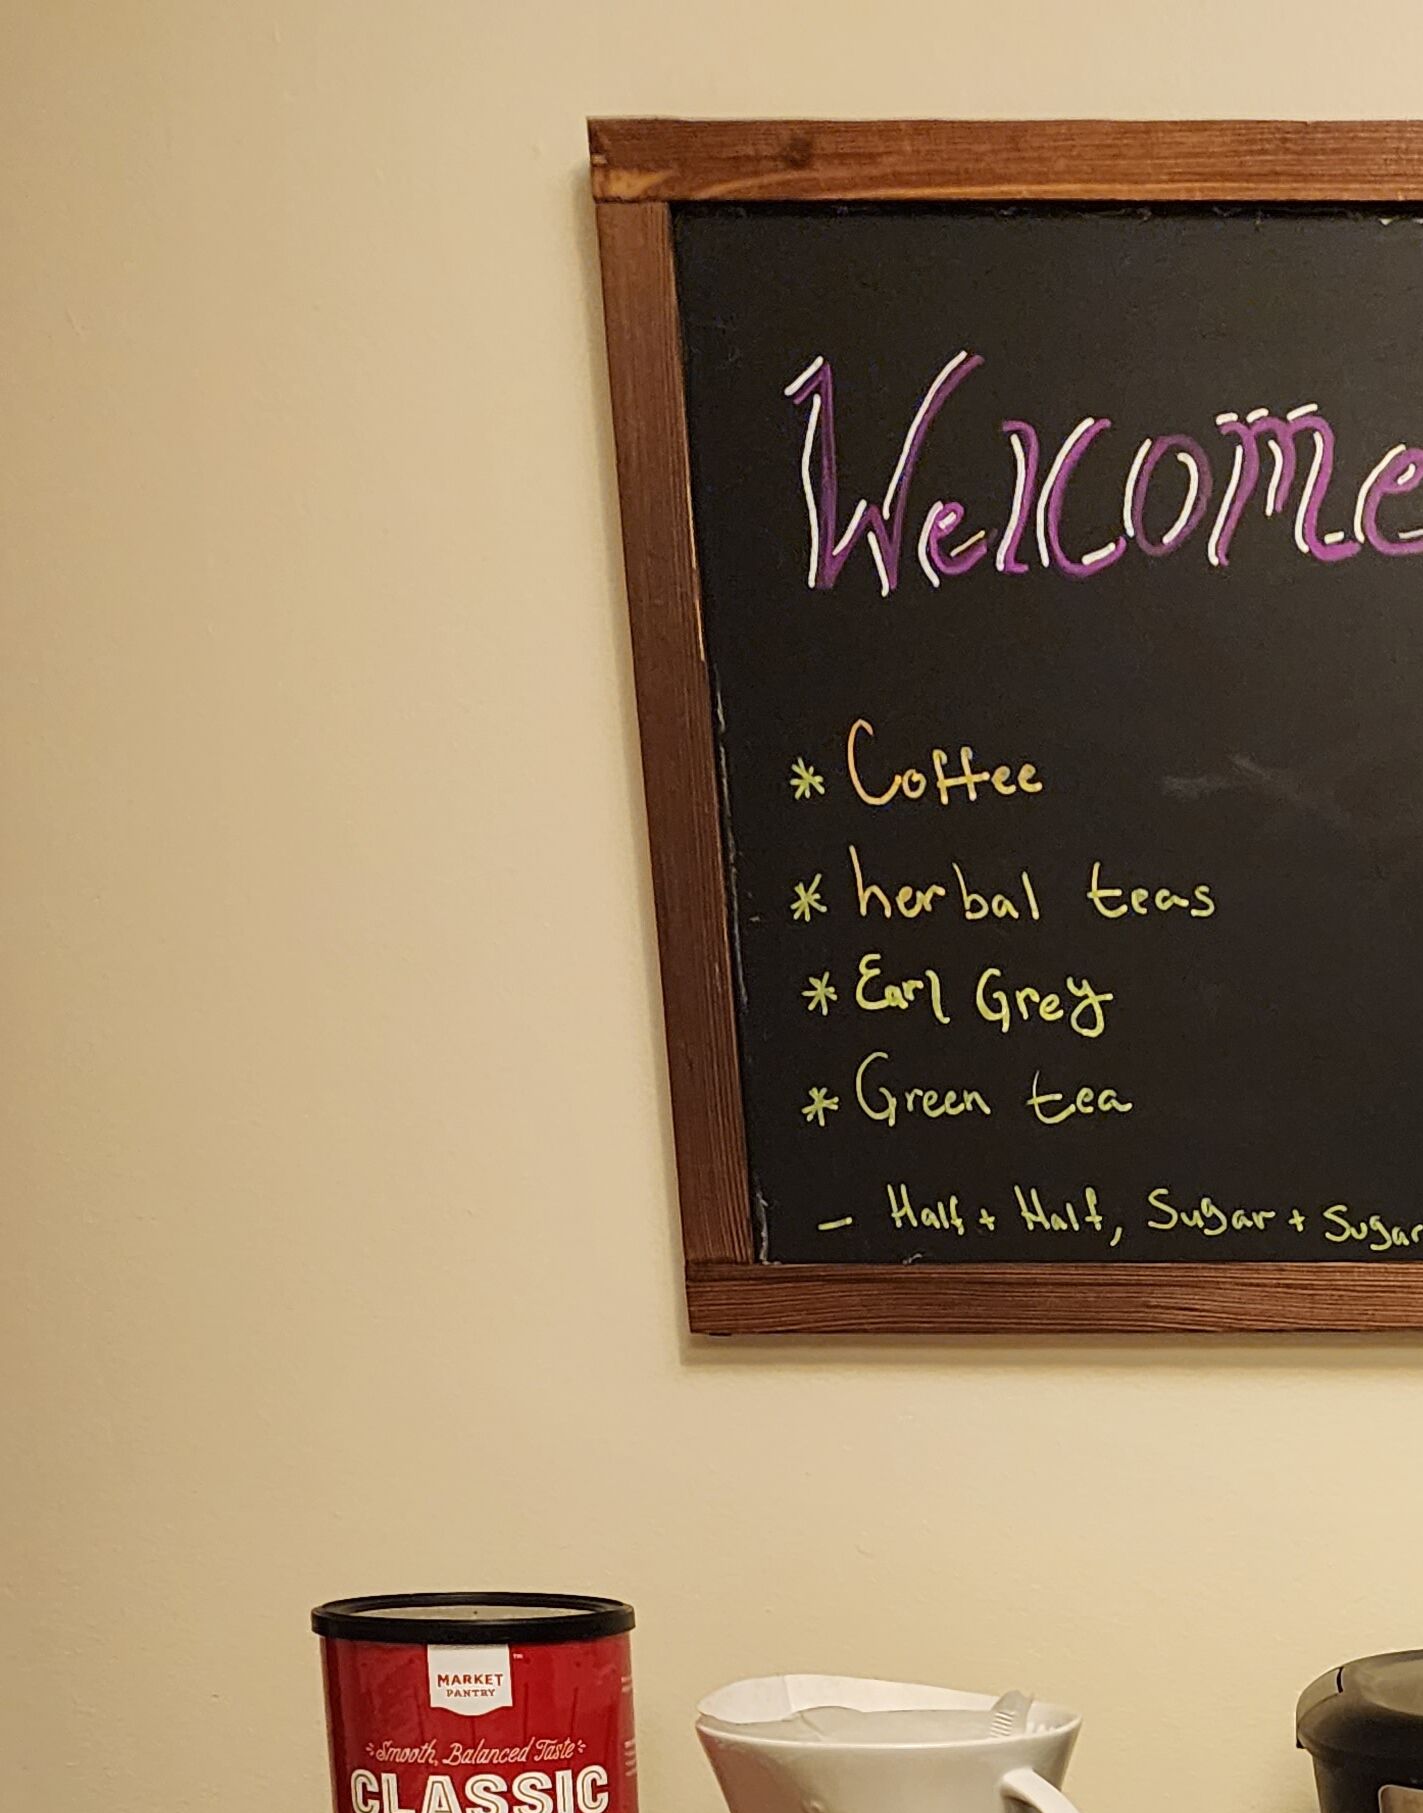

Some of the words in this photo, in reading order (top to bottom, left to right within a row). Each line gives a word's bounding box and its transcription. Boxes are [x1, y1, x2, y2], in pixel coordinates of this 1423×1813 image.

[847, 718, 1043, 806] Coffee
[849, 845, 1040, 920] herbal
[1086, 862, 1215, 918] teas
[855, 953, 951, 1024] Earl
[975, 967, 1114, 1038] Grey
[855, 1051, 991, 1127] Green
[1027, 1071, 1133, 1124] tea
[887, 1183, 965, 1236] Half
[1147, 1188, 1276, 1236] Sugar
[1323, 1204, 1423, 1251] Sugar
[437, 1673, 503, 1688] MARKET
[446, 1688, 496, 1698] PANTRY
[375, 1738, 439, 1766] Smooth,
[442, 1736, 536, 1766] Balanced
[534, 1736, 577, 1762] Taste
